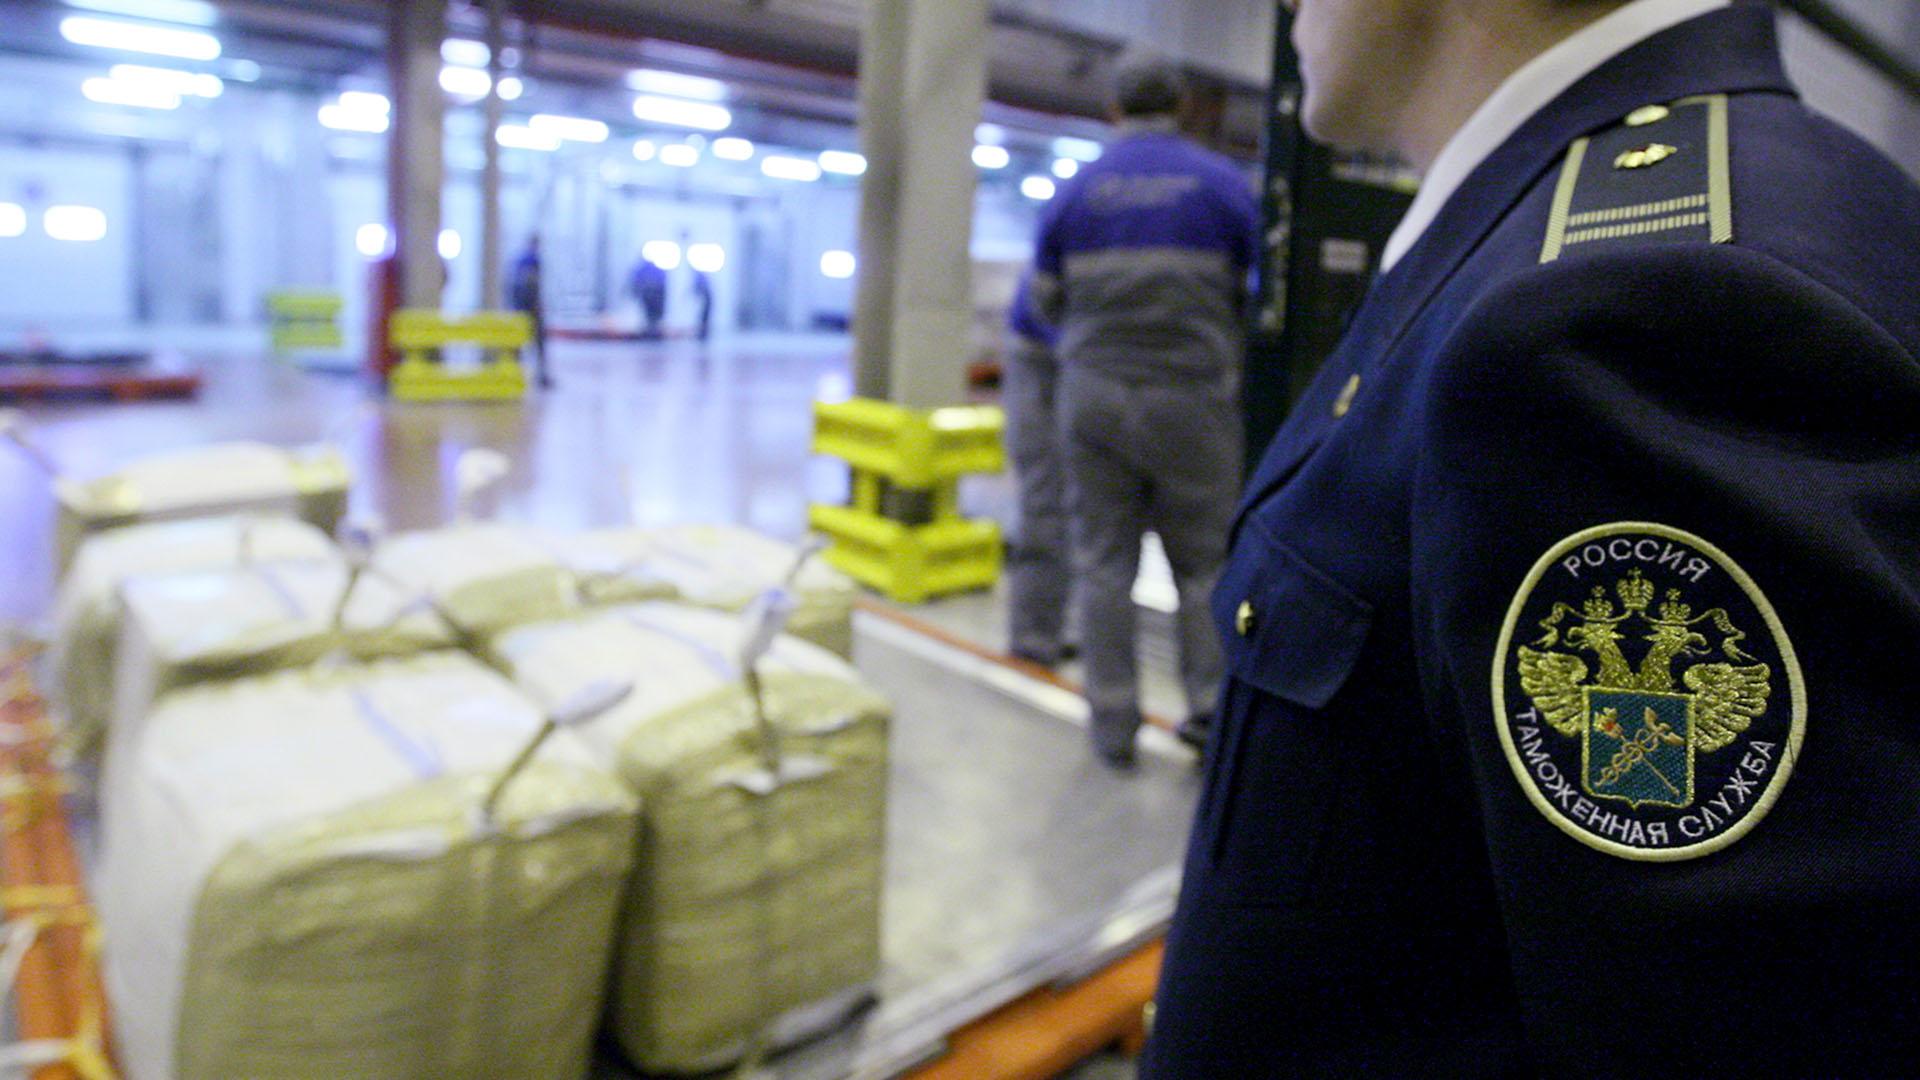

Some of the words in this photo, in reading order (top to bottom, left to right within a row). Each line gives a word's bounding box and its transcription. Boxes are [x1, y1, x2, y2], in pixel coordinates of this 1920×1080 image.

[1562, 538, 1712, 583] РОССИЯ
[1516, 707, 1669, 845] ТАМОЖЕННАЯ
[1679, 740, 1776, 838] СЛУЖБА
